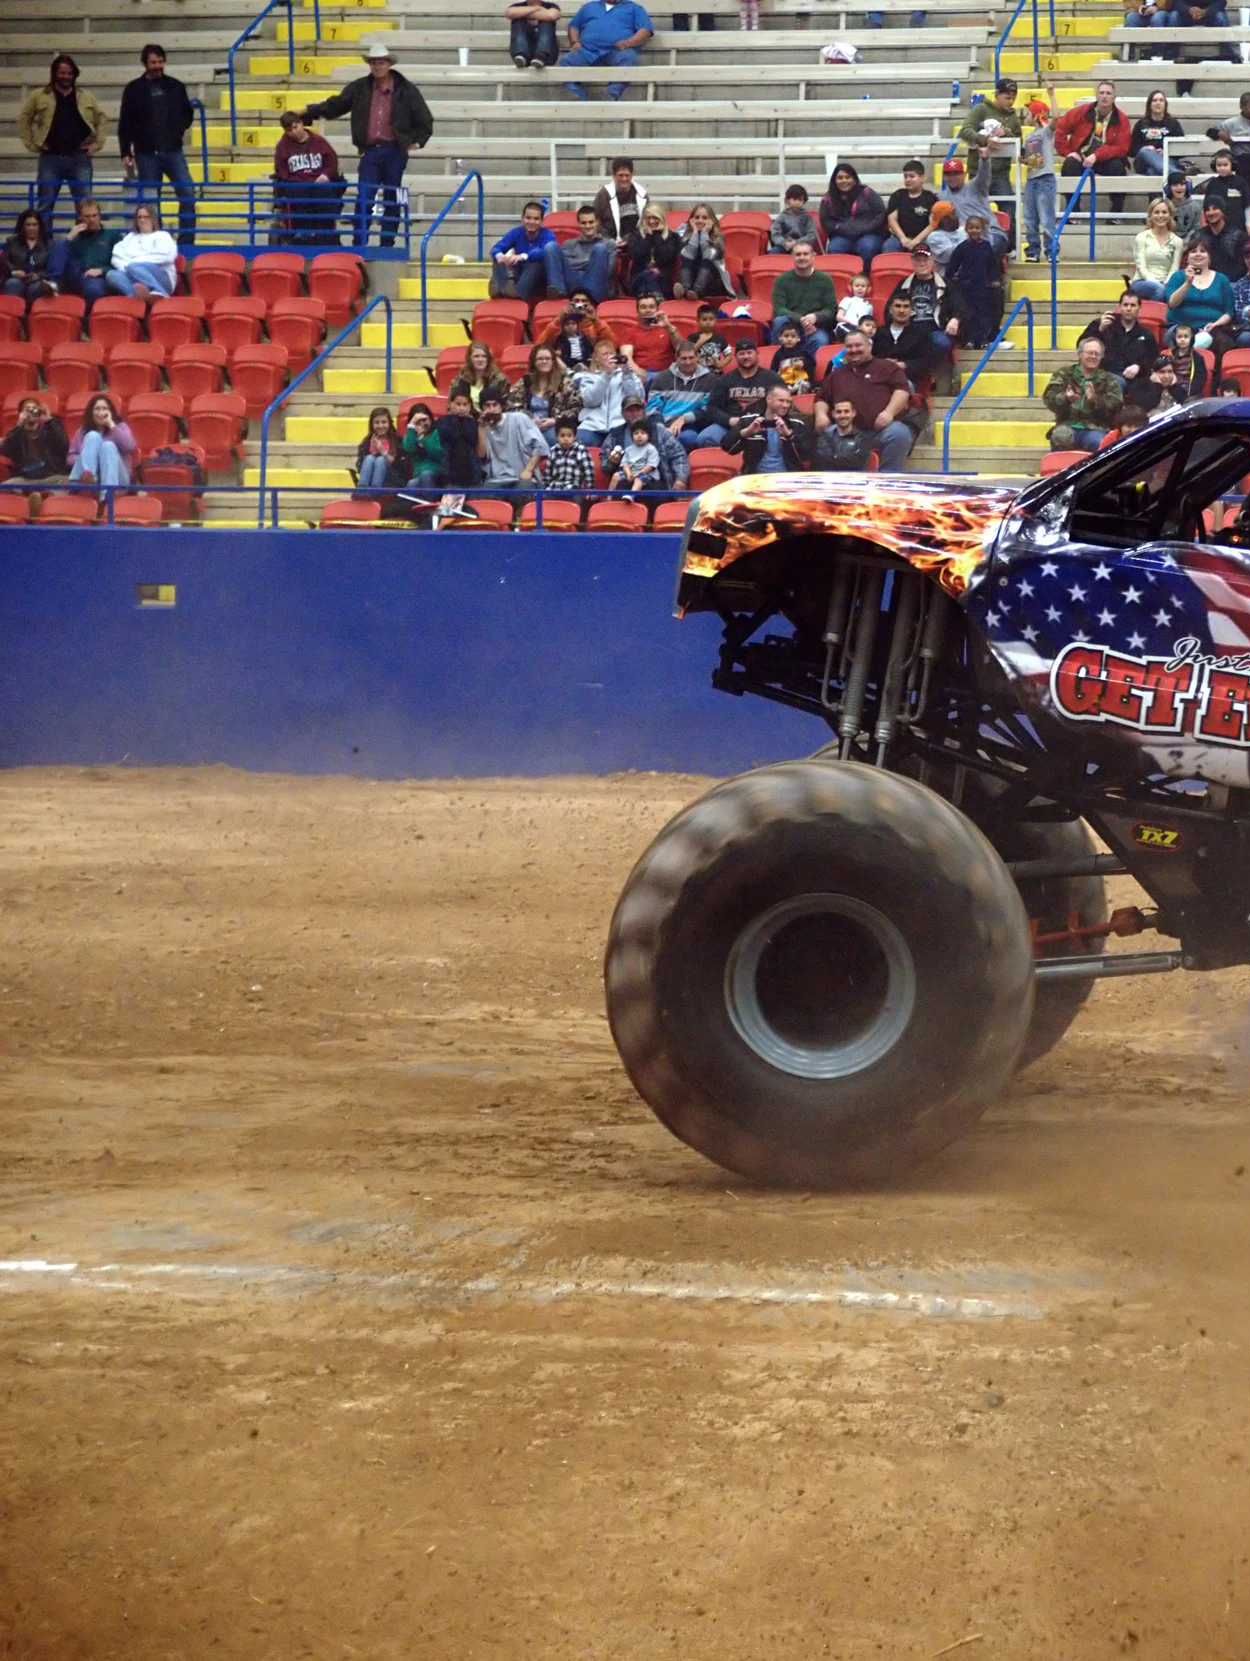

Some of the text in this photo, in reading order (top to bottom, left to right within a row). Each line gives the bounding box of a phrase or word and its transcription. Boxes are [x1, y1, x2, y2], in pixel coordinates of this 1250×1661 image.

[330, 28, 337, 39] 7
[1064, 24, 1071, 35] 7
[303, 64, 310, 74] 6
[1048, 60, 1054, 70] 6
[276, 98, 282, 109] 5
[246, 134, 254, 145] 4
[219, 170, 226, 181] 3
[729, 387, 766, 398] TEXAS
[1051, 644, 1195, 730] GET
